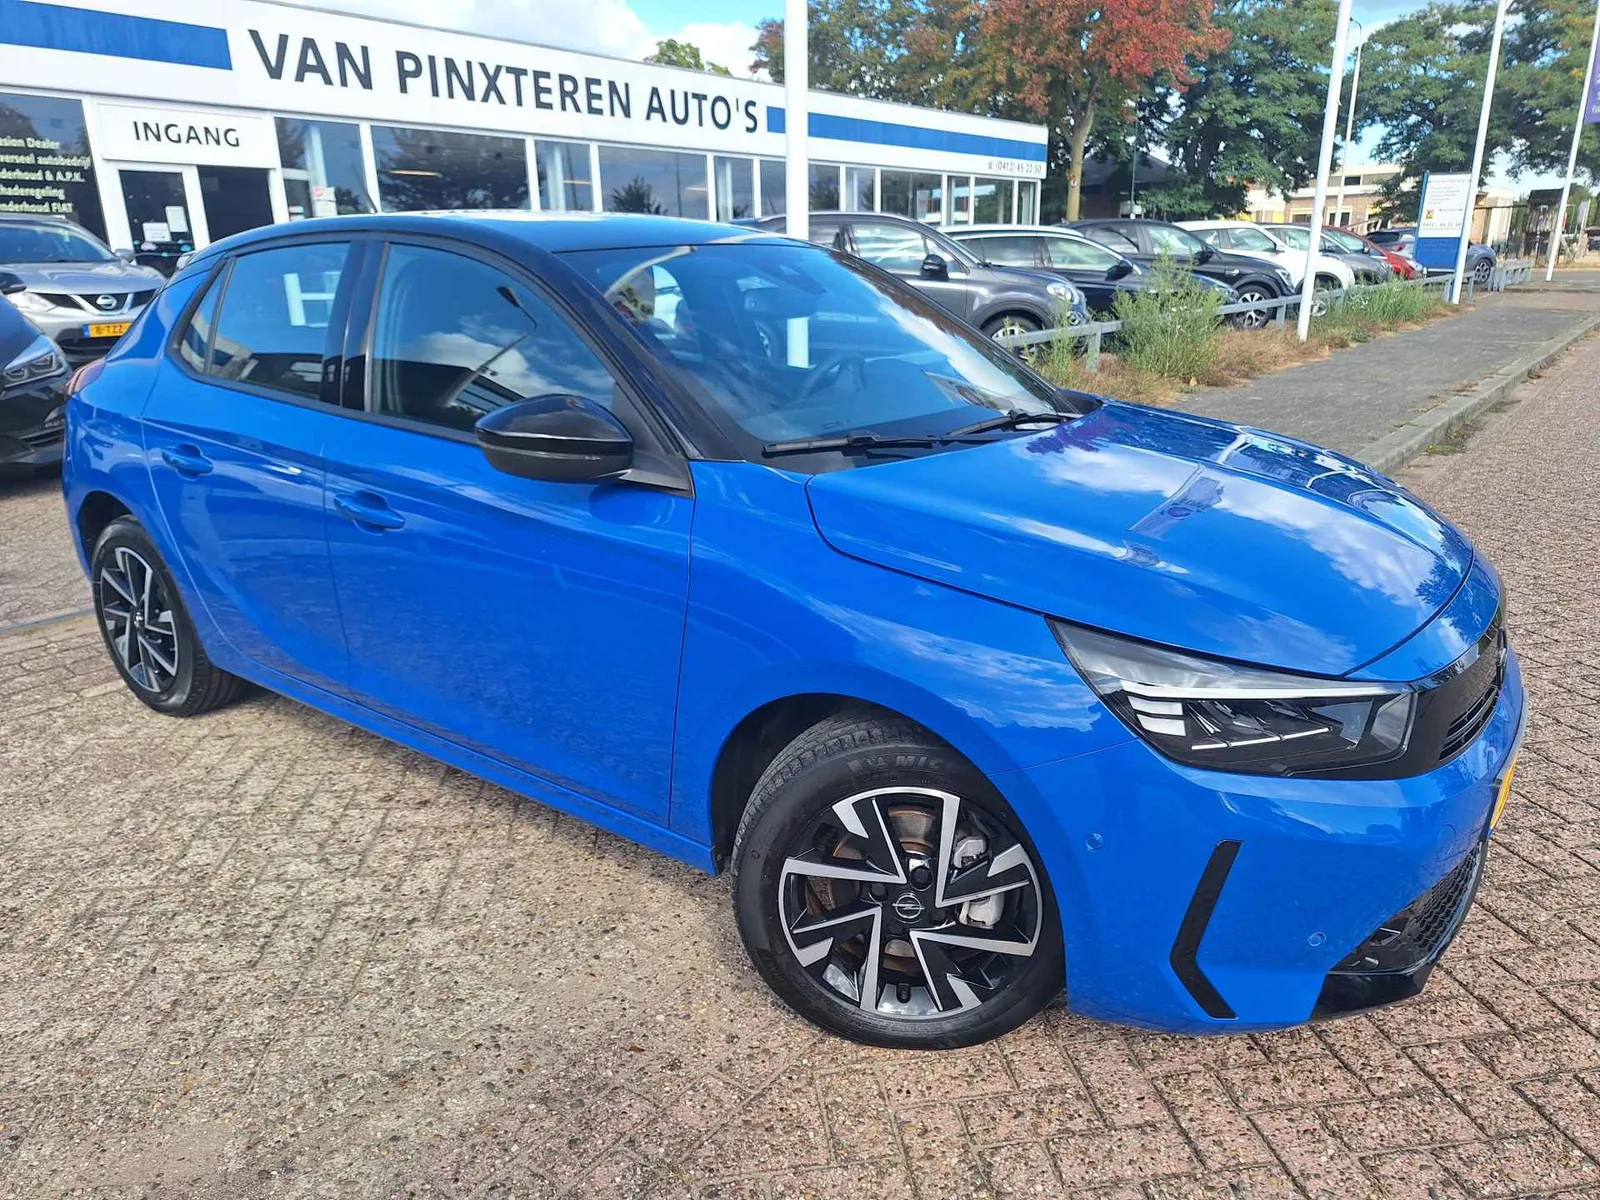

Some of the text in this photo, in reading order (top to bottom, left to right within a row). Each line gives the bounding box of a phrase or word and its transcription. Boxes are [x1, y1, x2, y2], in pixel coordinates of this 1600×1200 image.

[248, 28, 758, 134] VAN PINXTEREN AUTO'S
[133, 120, 240, 148] INGANG
[26, 137, 60, 149] Dealer
[37, 155, 91, 170] autobedrijf
[45, 170, 54, 181] &
[51, 202, 73, 213] FIAT
